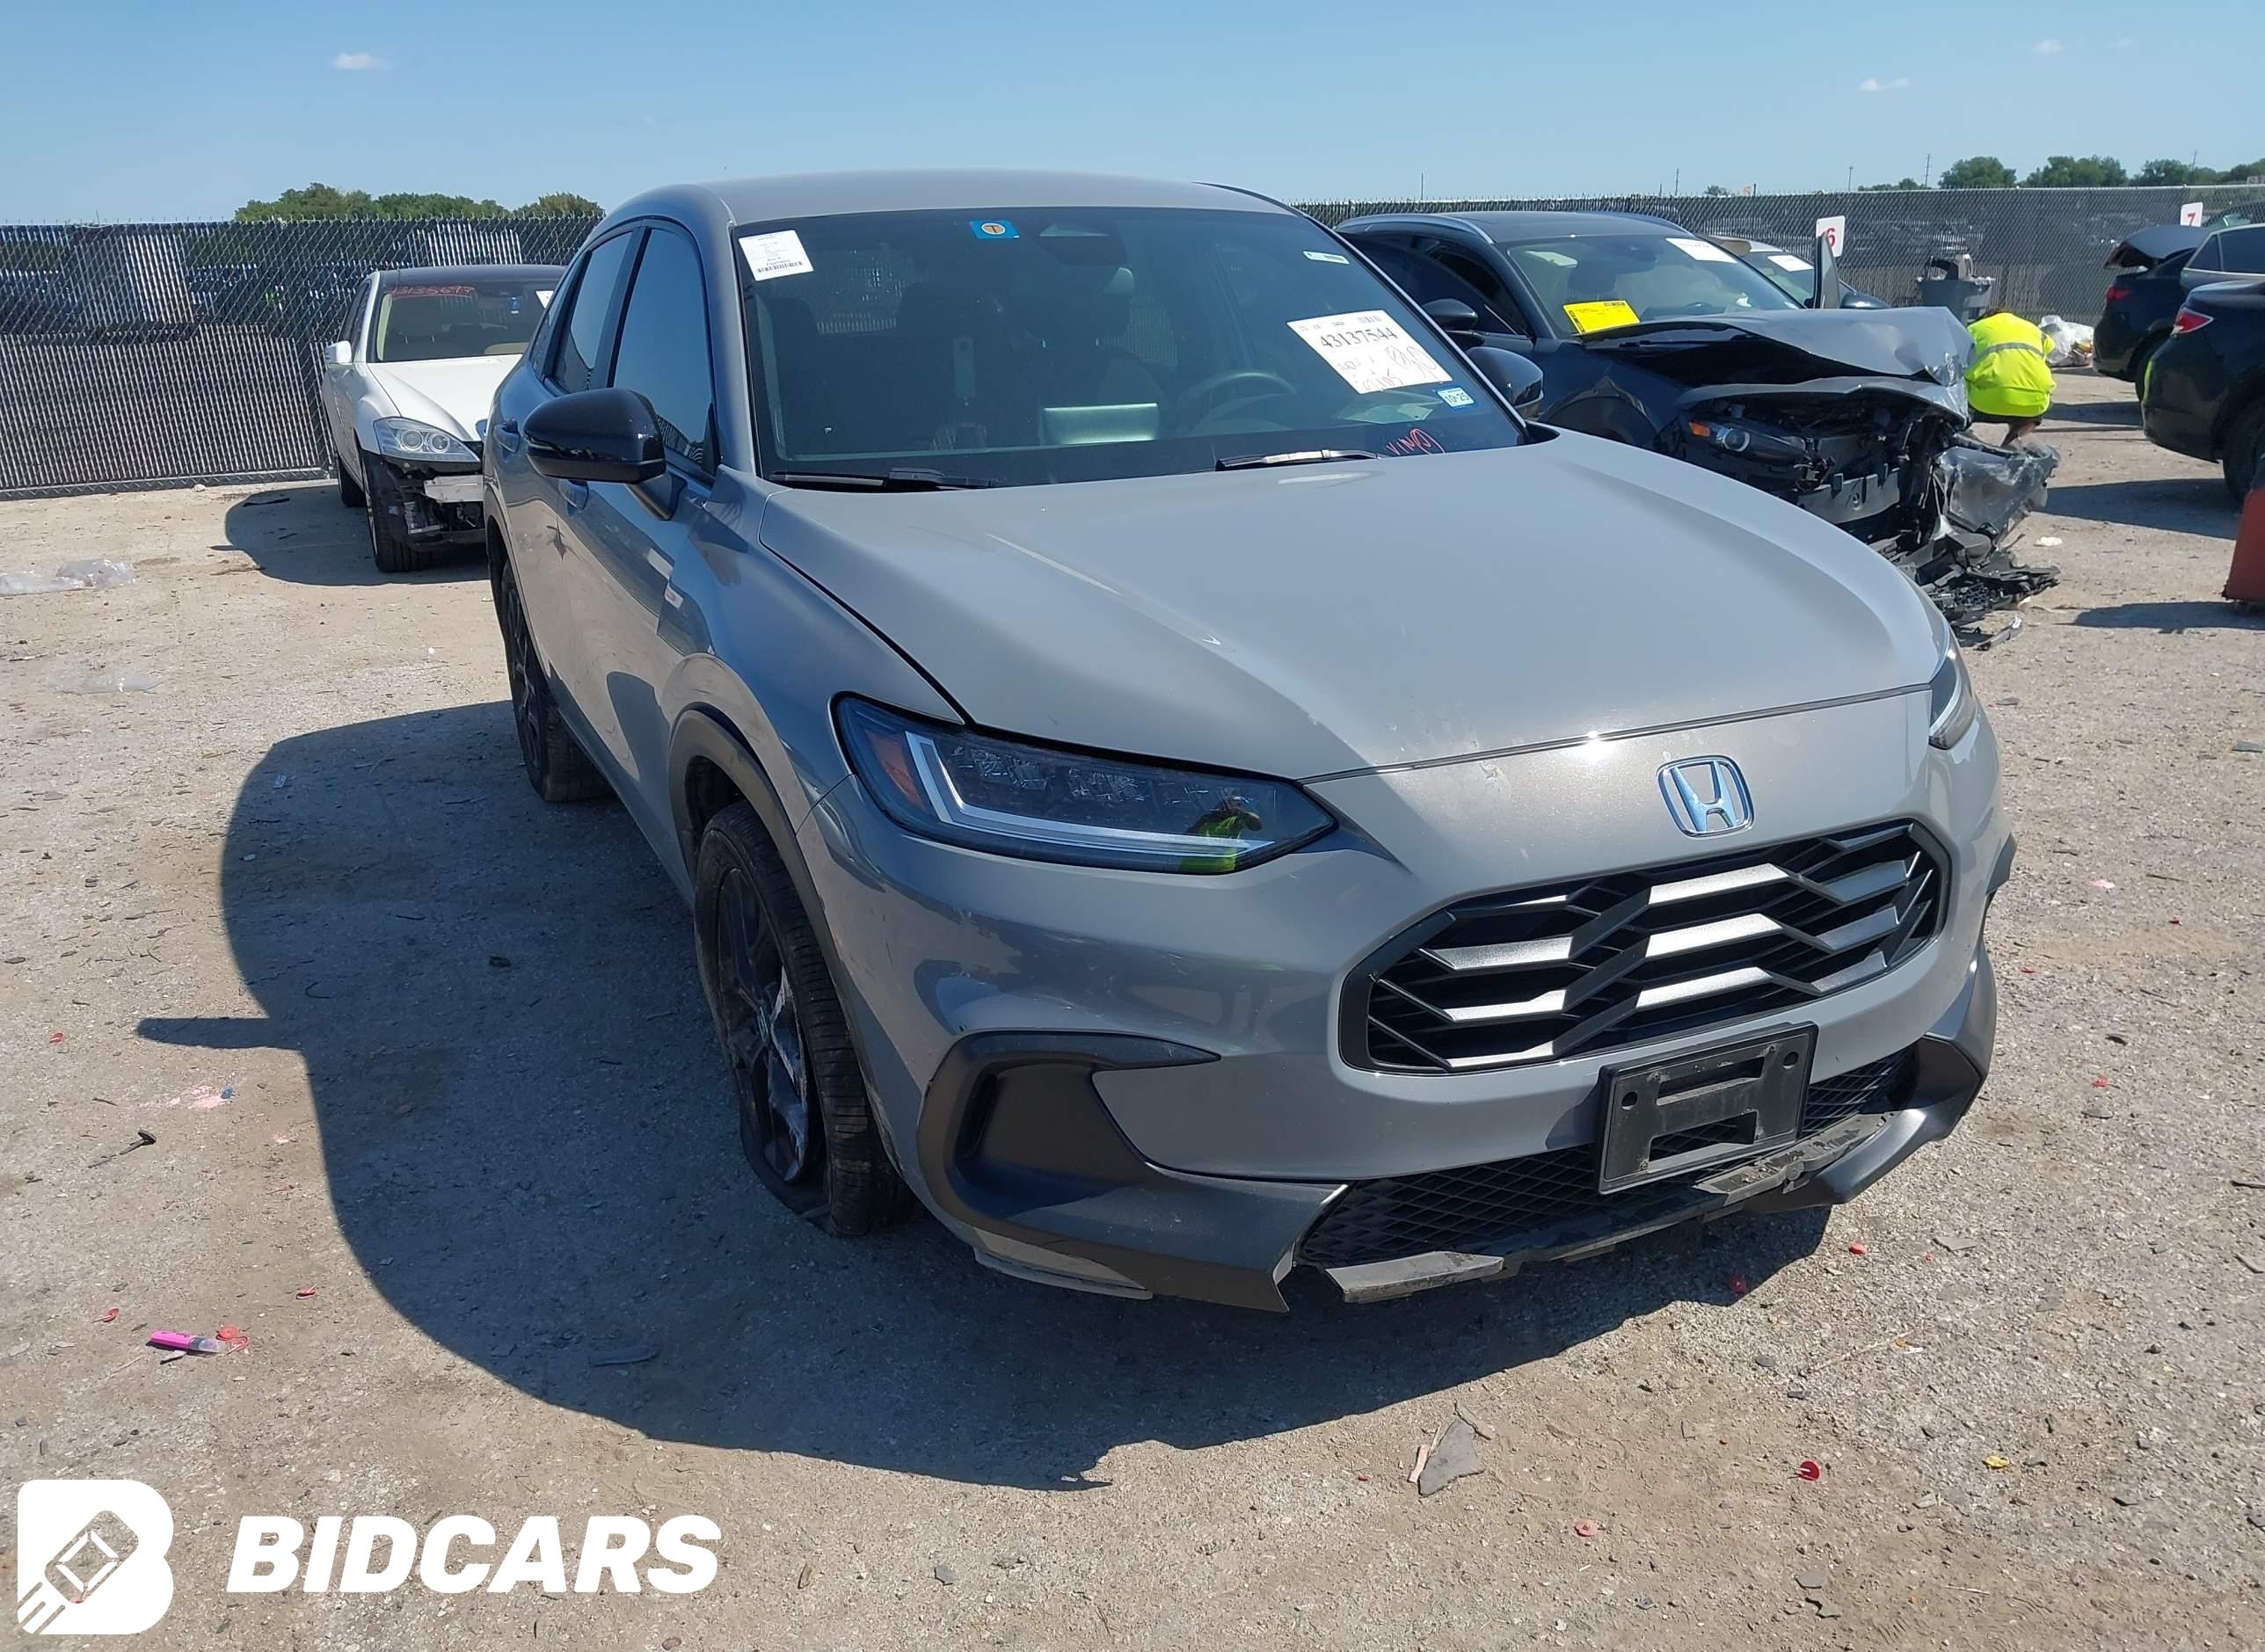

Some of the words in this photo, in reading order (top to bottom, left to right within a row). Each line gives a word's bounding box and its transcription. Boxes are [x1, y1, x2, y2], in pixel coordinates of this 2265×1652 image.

[2187, 212, 2196, 227] 7
[1825, 228, 1836, 247] 6
[1320, 326, 1398, 348] 43137544
